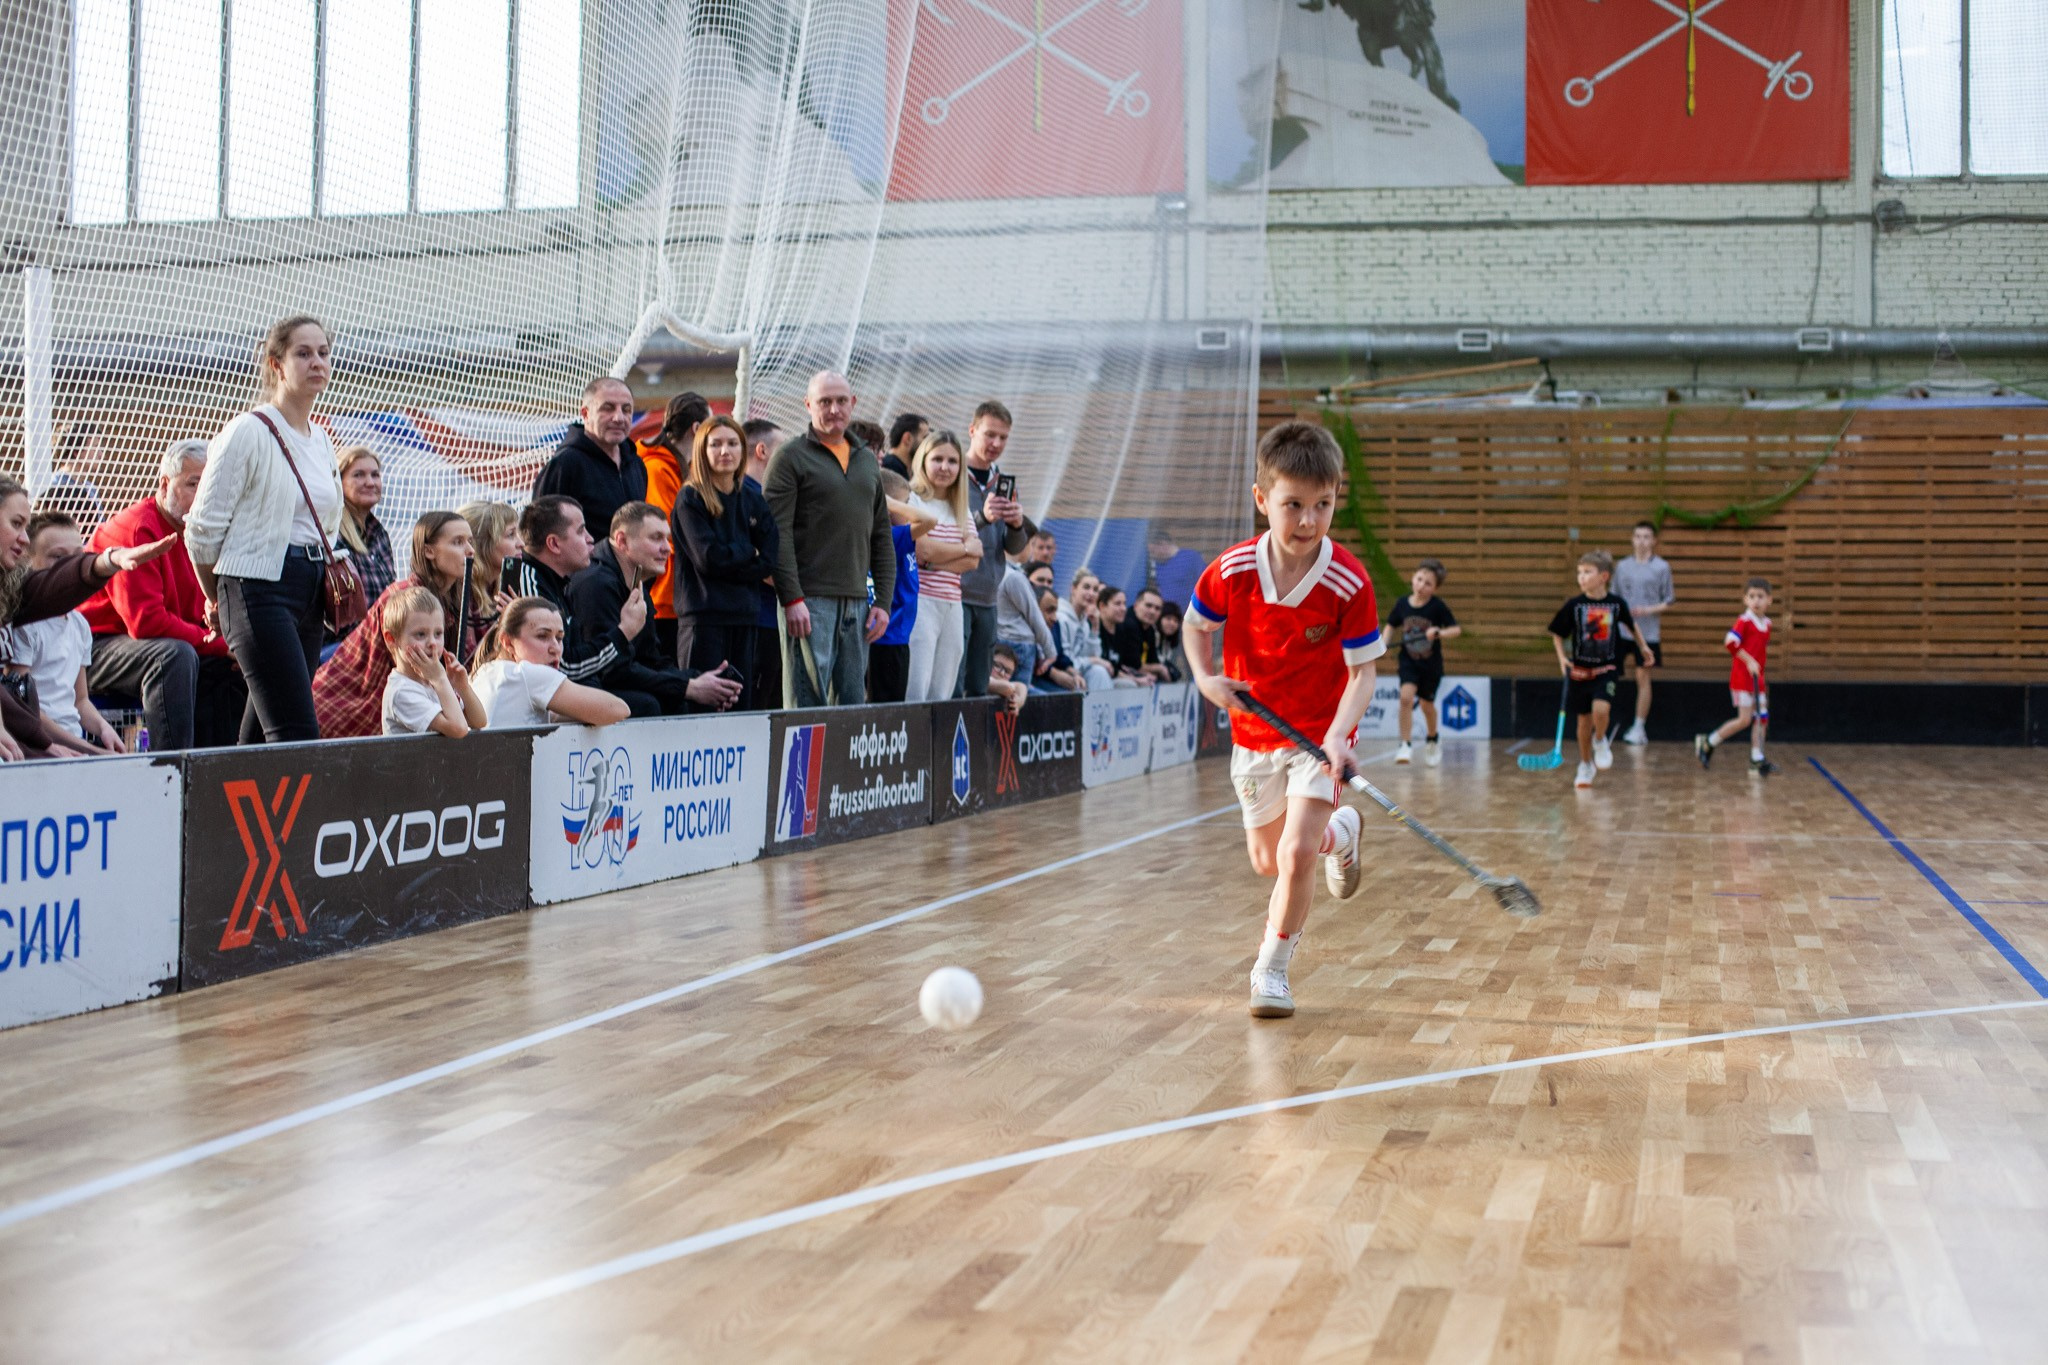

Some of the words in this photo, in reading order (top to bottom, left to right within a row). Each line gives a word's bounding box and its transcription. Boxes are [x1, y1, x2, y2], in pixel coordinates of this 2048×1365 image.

[850, 720, 909, 768] нффр.рф
[1018, 729, 1076, 765] OXDOG
[651, 745, 747, 792] МИНСПОРТ
[829, 769, 926, 819] #russiafloorball
[313, 799, 506, 878] OXDOG
[663, 796, 731, 844] РОССИИ
[1, 810, 117, 884] ПОРТ
